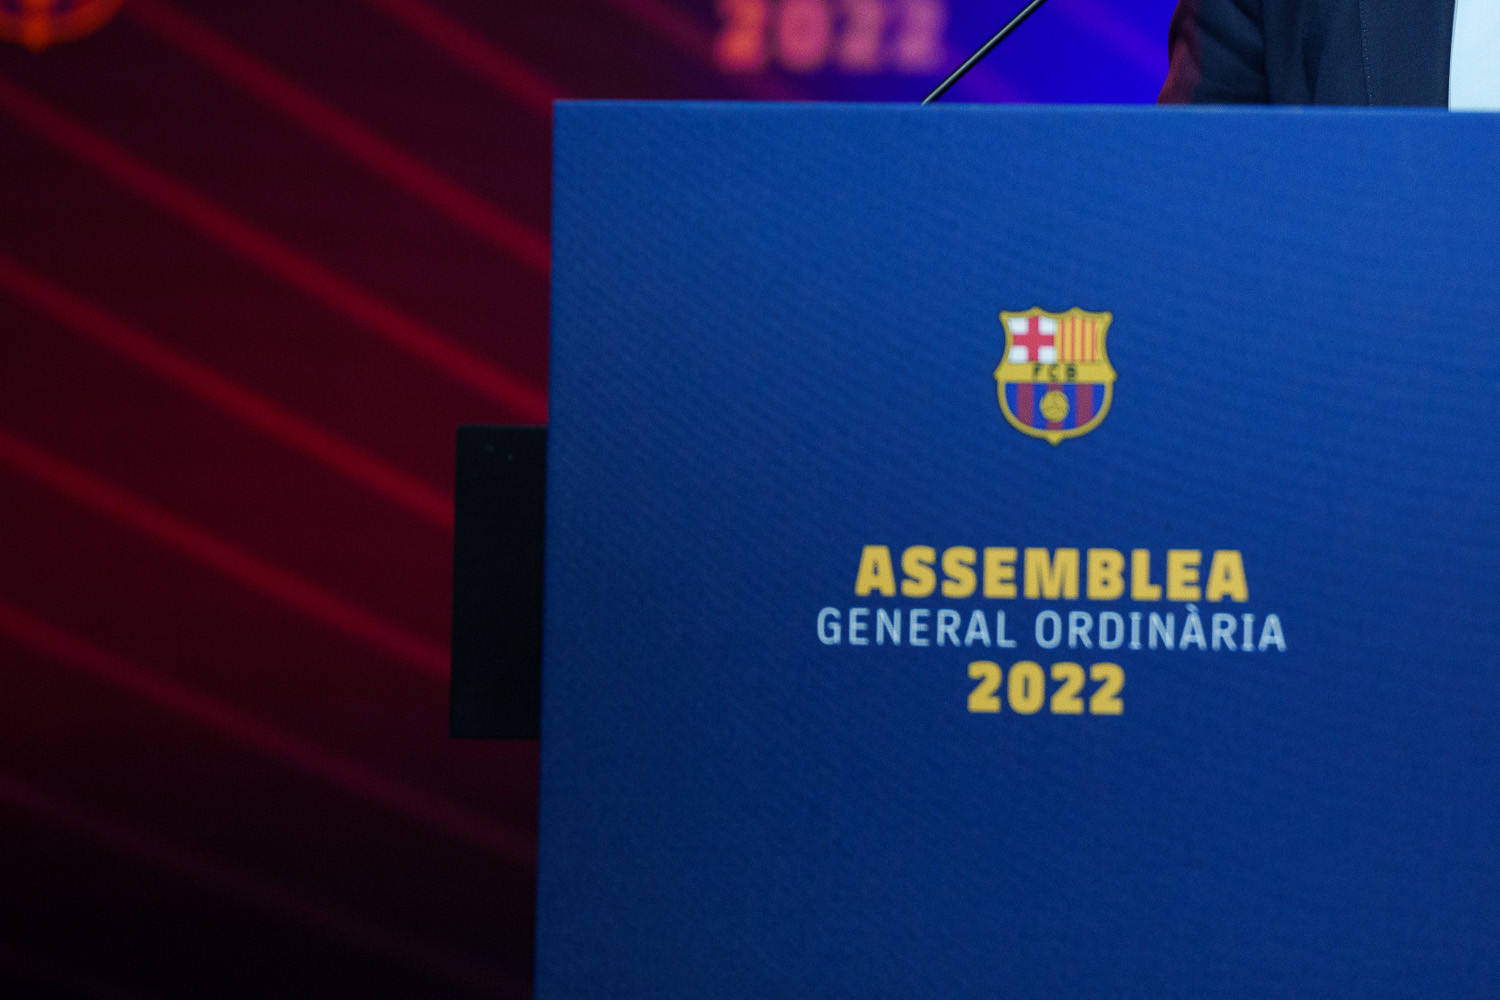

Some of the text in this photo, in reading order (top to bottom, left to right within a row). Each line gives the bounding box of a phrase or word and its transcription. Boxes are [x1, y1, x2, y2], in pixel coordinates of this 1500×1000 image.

[1032, 362, 1078, 381] FCB
[855, 545, 1249, 602] ASSEMBLEA
[816, 602, 1287, 652] GENERAL ORDINÀRIA
[967, 660, 1126, 716] 2022
